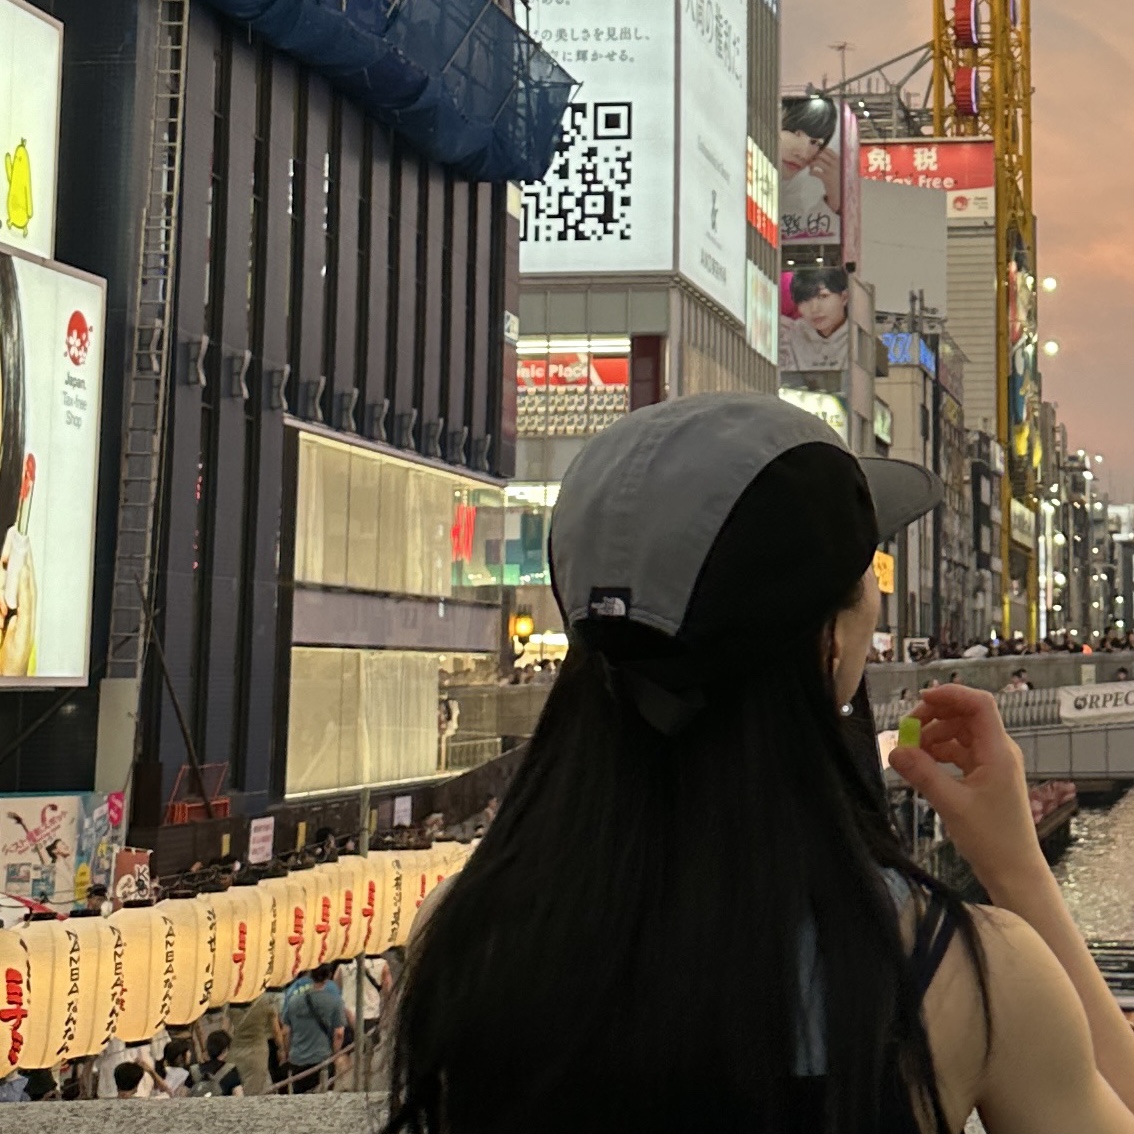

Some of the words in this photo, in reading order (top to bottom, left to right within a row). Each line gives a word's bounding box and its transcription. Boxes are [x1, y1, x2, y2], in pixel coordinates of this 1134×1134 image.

[533, 26, 650, 42] の美しさを見出し、
[867, 147, 938, 172] 免税
[918, 174, 955, 188] Free
